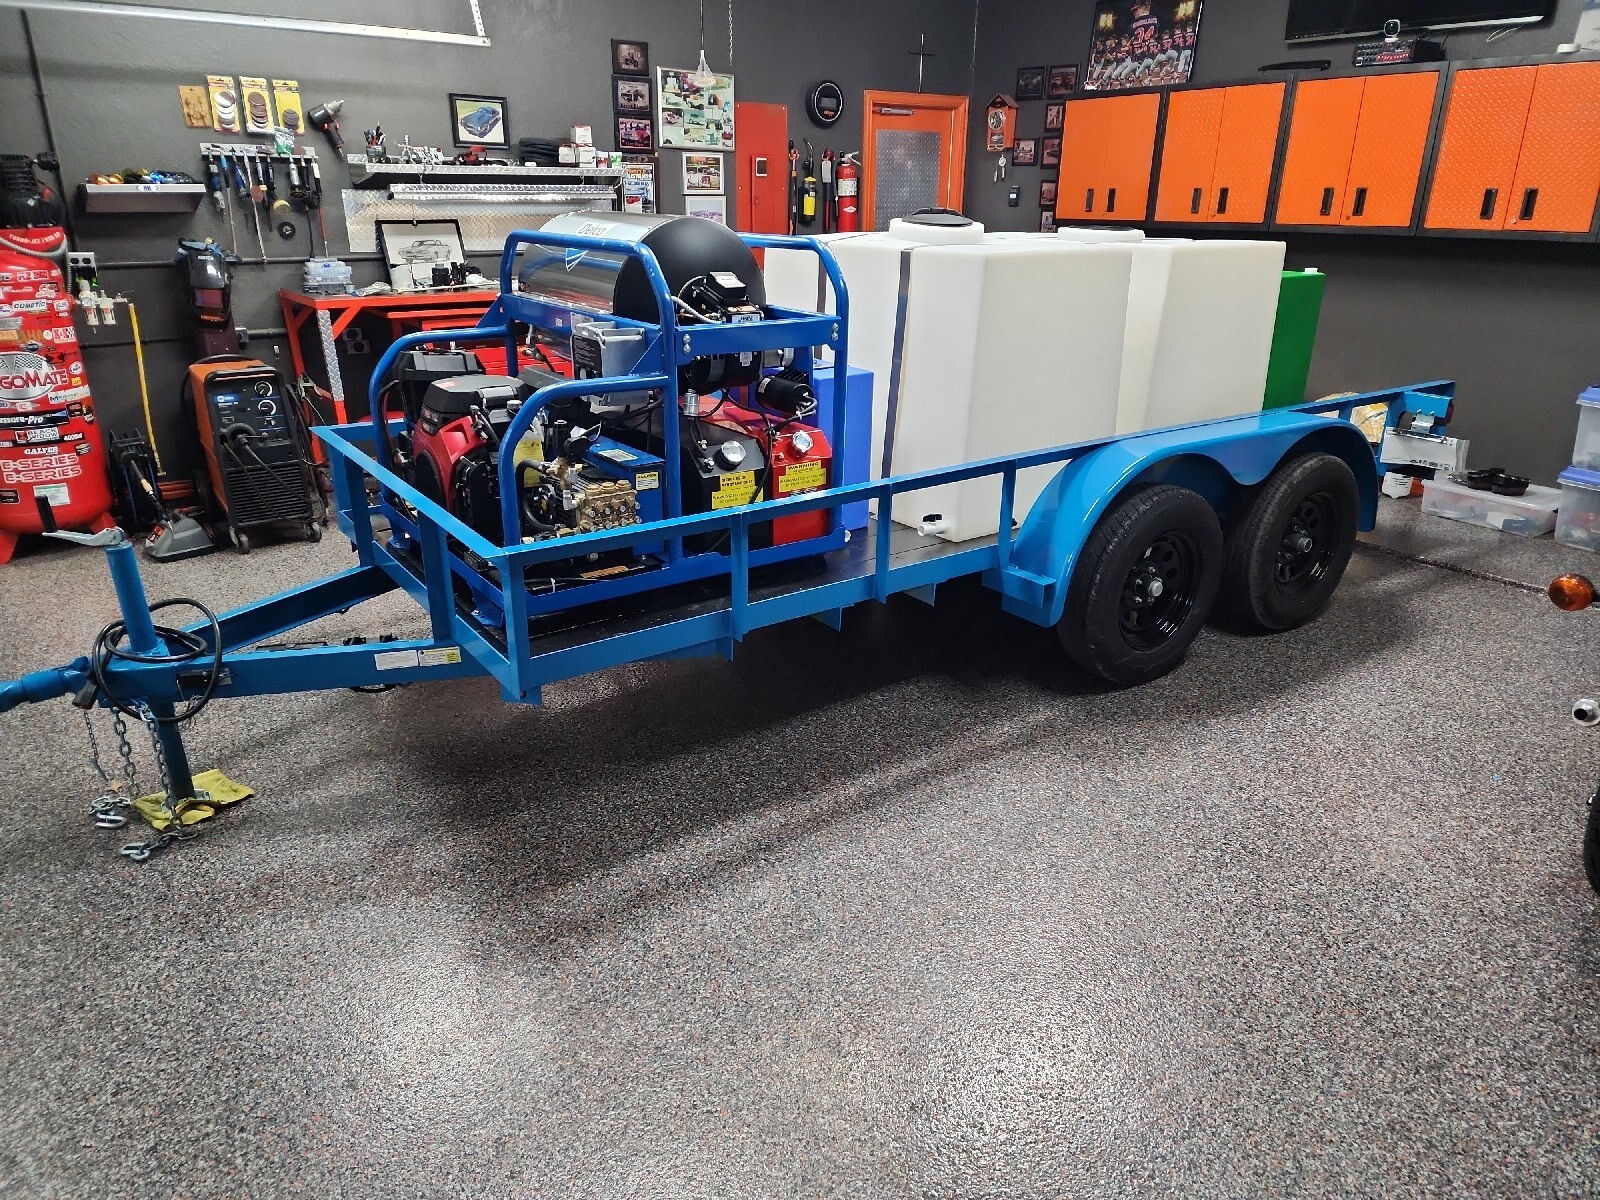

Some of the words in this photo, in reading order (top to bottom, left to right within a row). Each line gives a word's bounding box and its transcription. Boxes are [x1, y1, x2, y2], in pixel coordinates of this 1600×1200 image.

[578, 224, 606, 236] Delco
[27, 427, 57, 435] BLACK
[1, 453, 79, 470] E-SERIES
[787, 461, 819, 471] WARNING
[3, 465, 82, 482] E-SERIES
